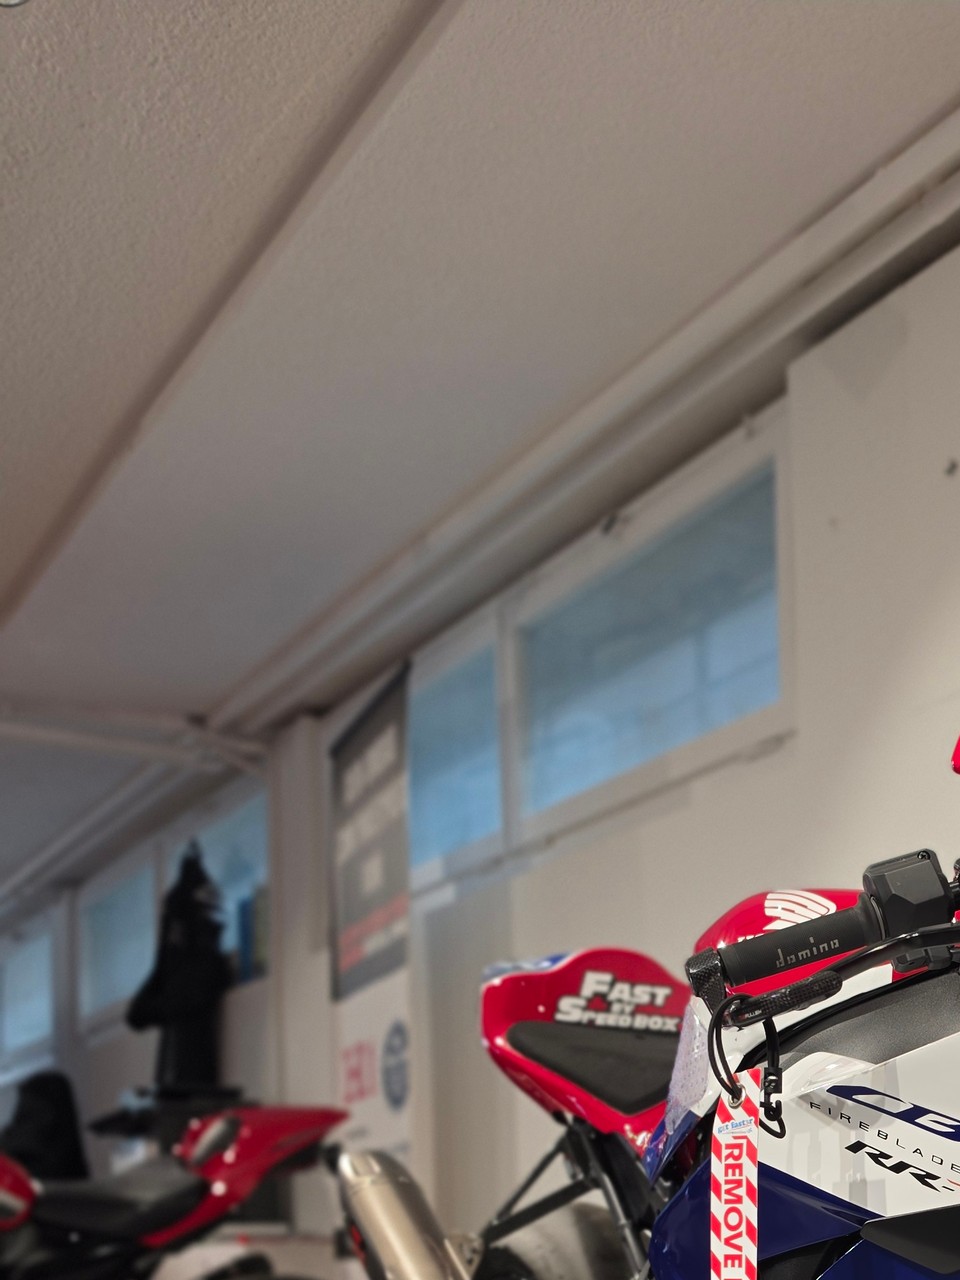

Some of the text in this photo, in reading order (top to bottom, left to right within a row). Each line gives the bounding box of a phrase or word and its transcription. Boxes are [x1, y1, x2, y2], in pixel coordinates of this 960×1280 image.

[776, 936, 840, 968] domino
[580, 971, 672, 1007] FAST
[723, 1142, 744, 1269] REMOVE
